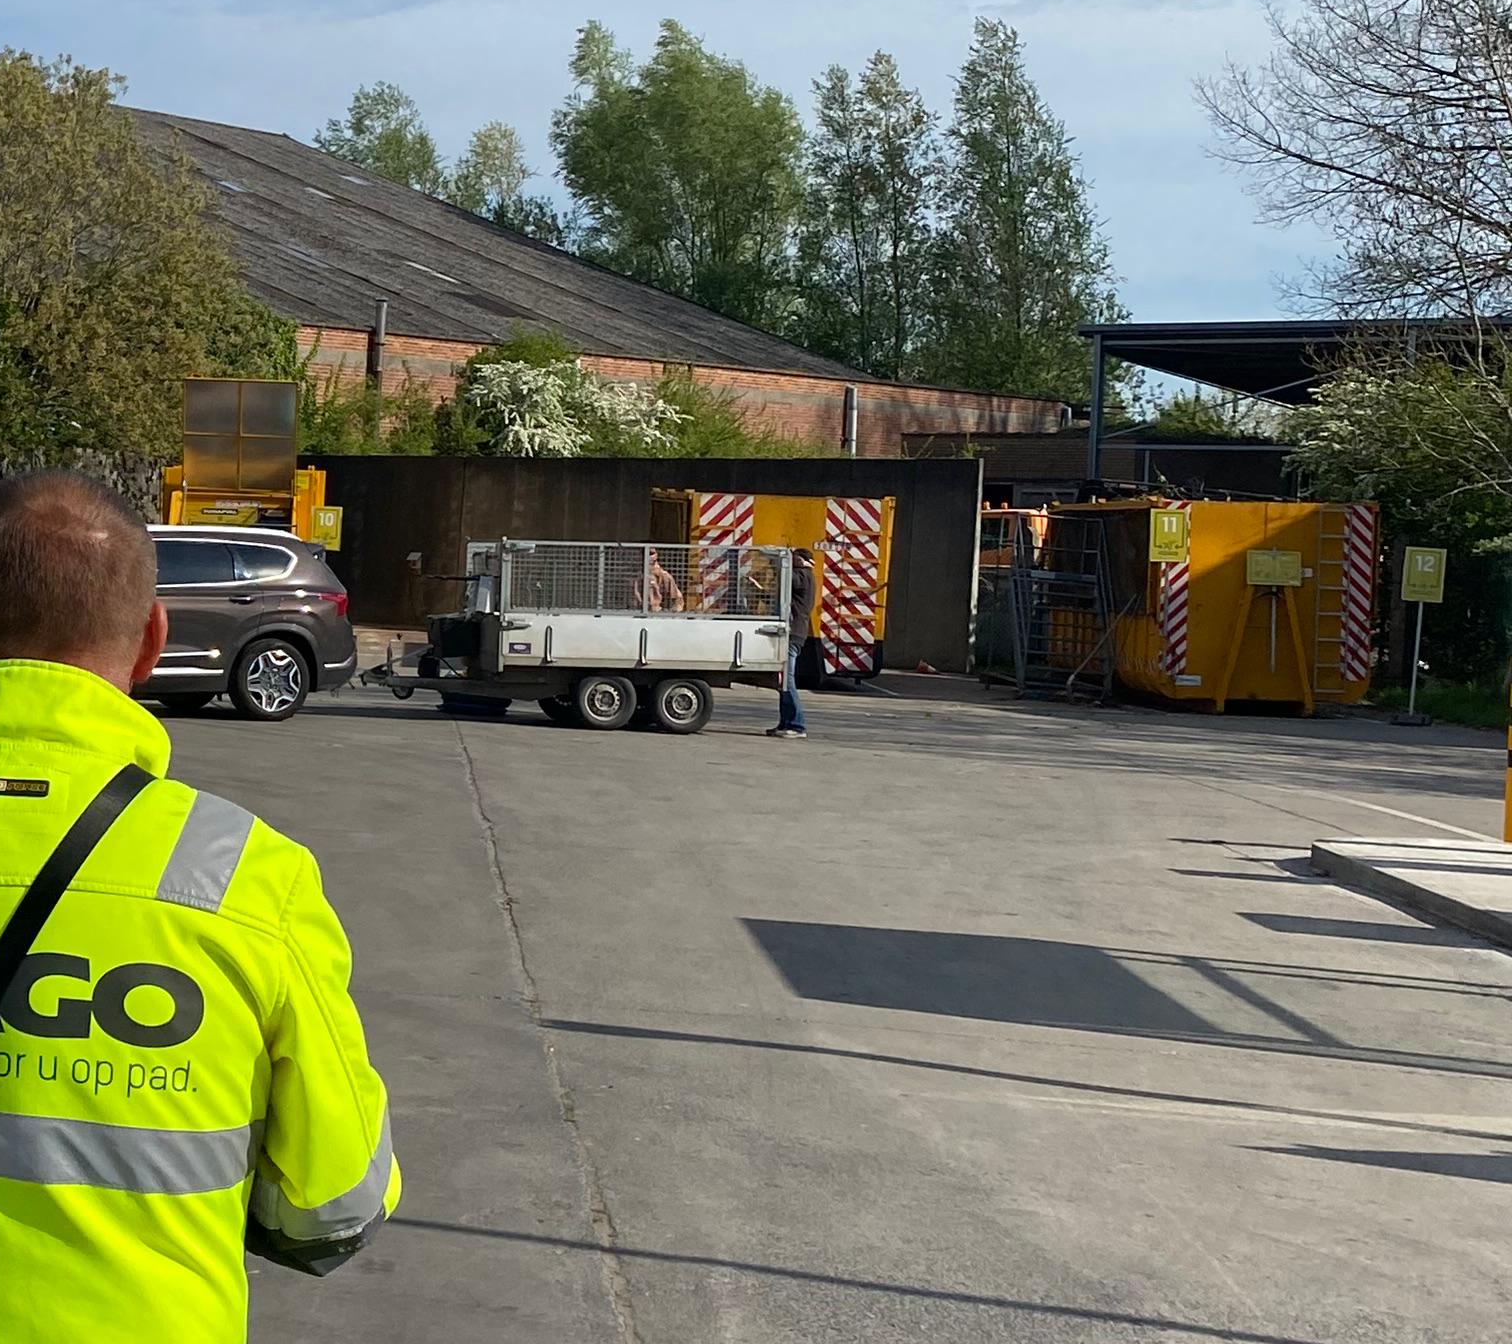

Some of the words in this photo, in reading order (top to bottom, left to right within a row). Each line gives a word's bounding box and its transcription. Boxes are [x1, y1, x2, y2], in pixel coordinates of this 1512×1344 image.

[318, 512, 335, 527] 10
[1161, 516, 1178, 533] 11
[1415, 555, 1435, 572] 12
[38, 1055, 58, 1081] u
[71, 1058, 114, 1095] op
[127, 1060, 198, 1098] pad.
